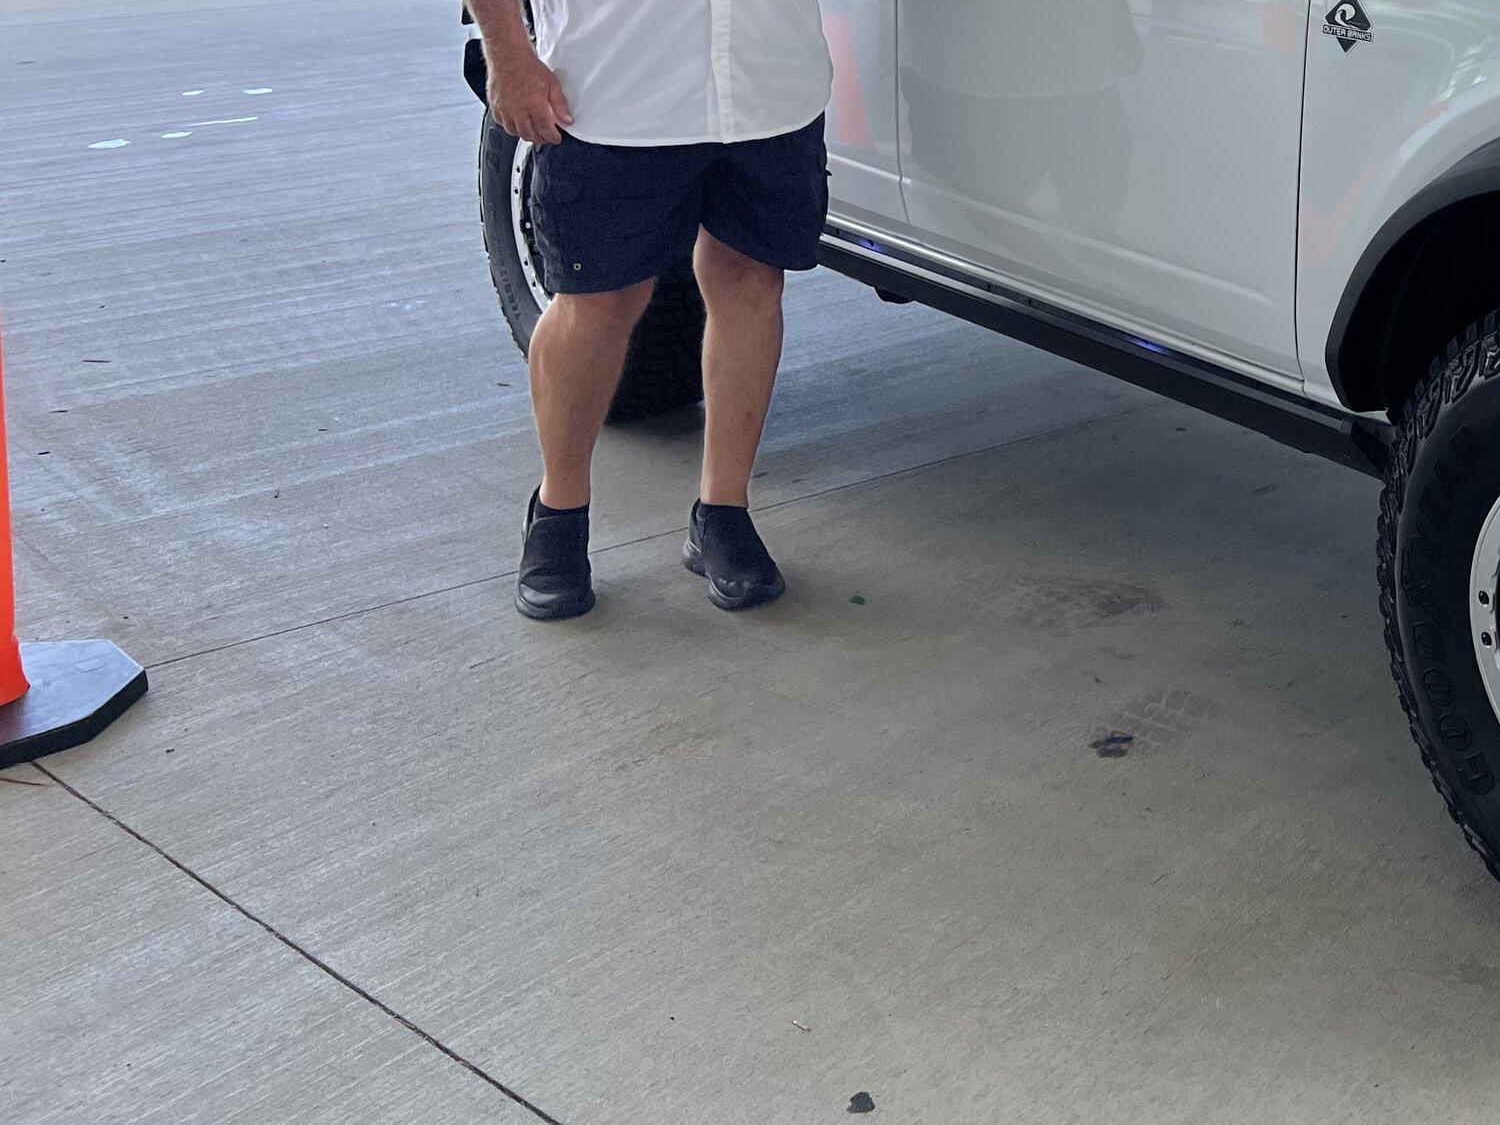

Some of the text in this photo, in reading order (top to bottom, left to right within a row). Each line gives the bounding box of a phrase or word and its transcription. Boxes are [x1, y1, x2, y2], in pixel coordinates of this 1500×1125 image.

[1323, 26, 1371, 42] OUTER BANKS
[1400, 424, 1497, 796] GOODYEAR
